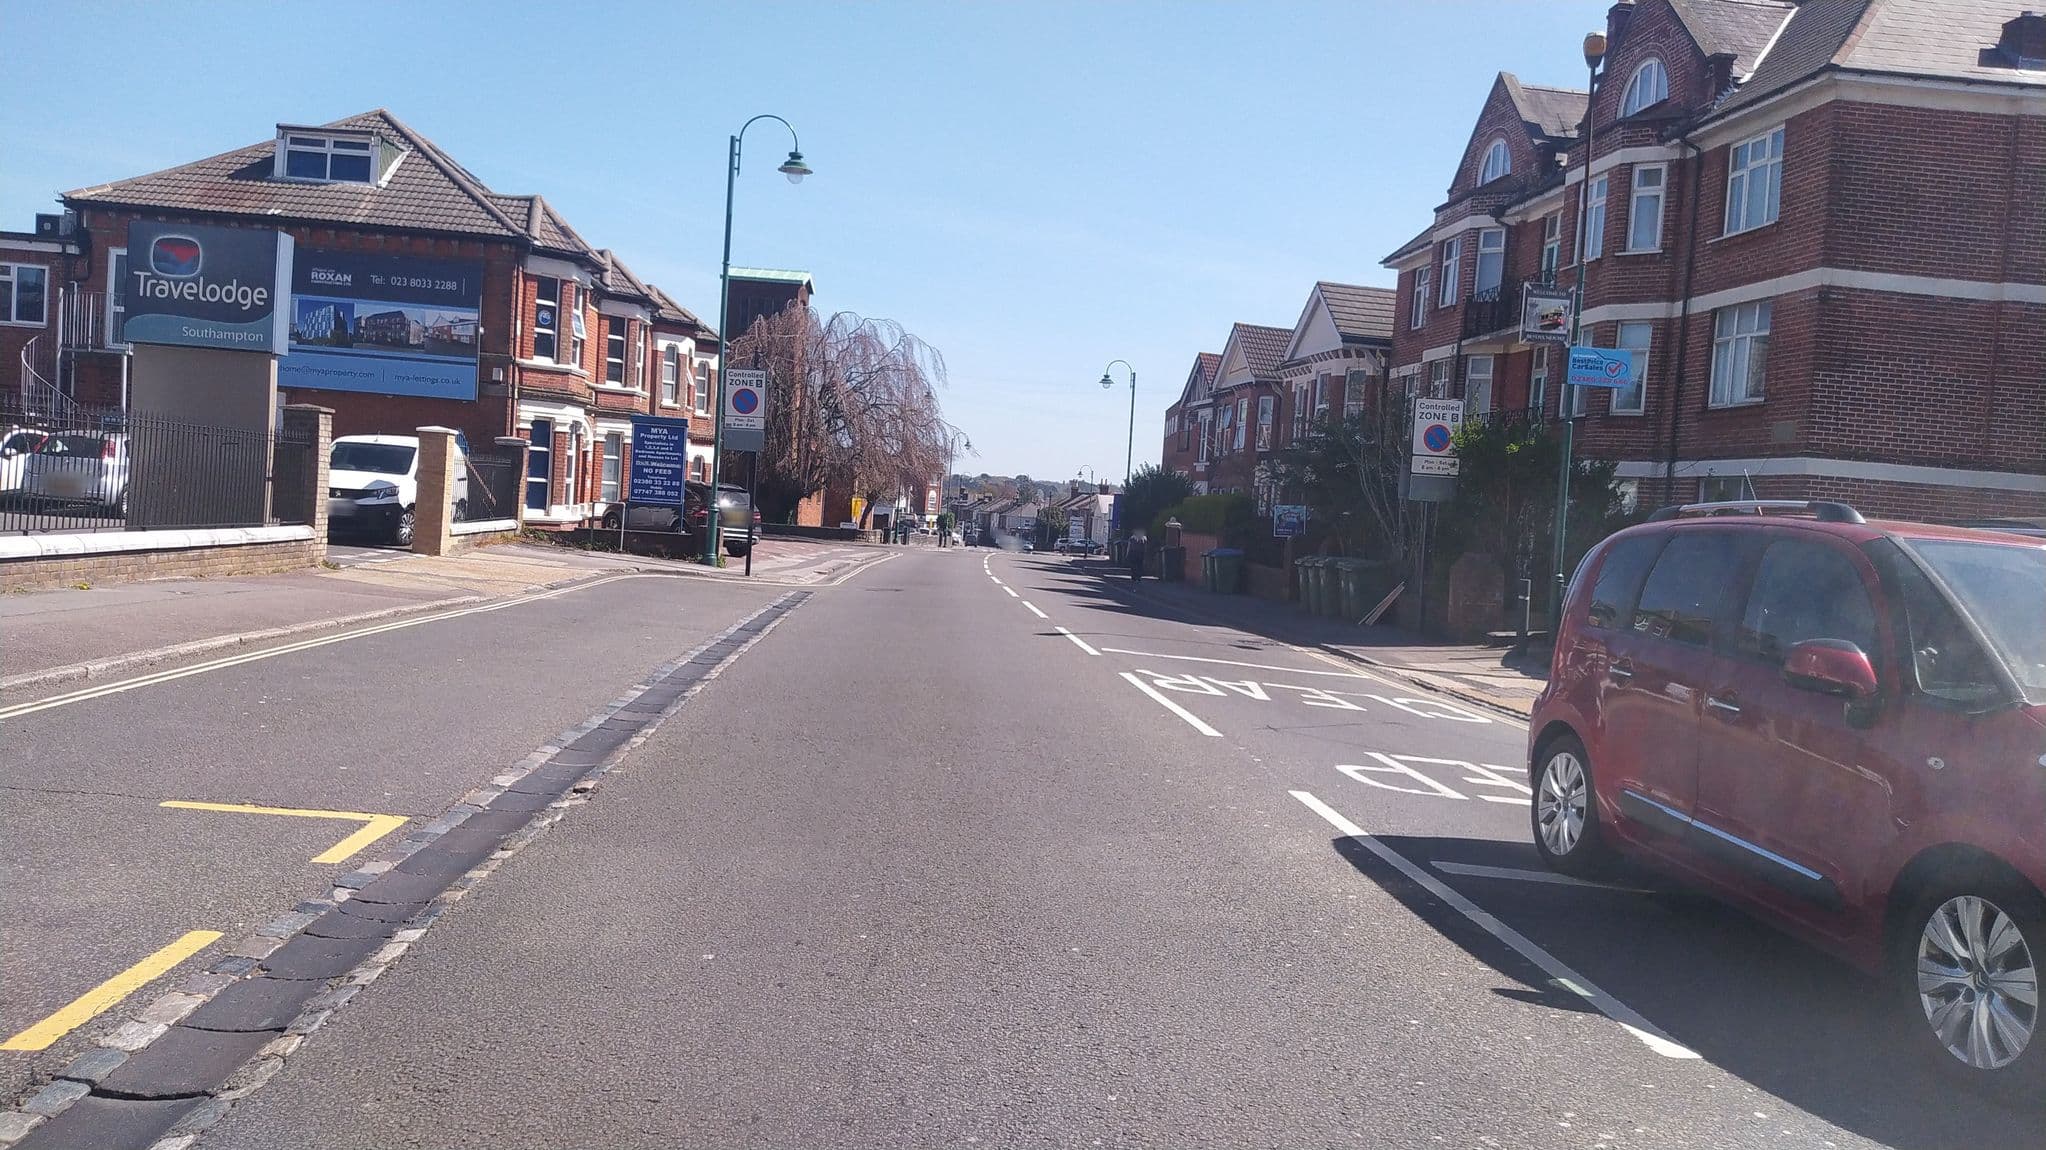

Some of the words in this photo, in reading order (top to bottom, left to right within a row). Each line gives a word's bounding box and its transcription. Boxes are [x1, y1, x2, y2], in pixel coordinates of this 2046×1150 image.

[311, 271, 352, 282] ROXAN
[370, 274, 385, 285] Tel:
[390, 276, 407, 286] 023
[410, 278, 432, 289] 8033
[434, 280, 457, 291] 2288
[133, 271, 268, 310] Travelodge
[182, 326, 263, 342] Southampton
[728, 371, 764, 379] Controlled
[1419, 402, 1460, 411] Controlled
[1419, 412, 1448, 421] ZONE
[1135, 668, 1493, 723] CLEAR
